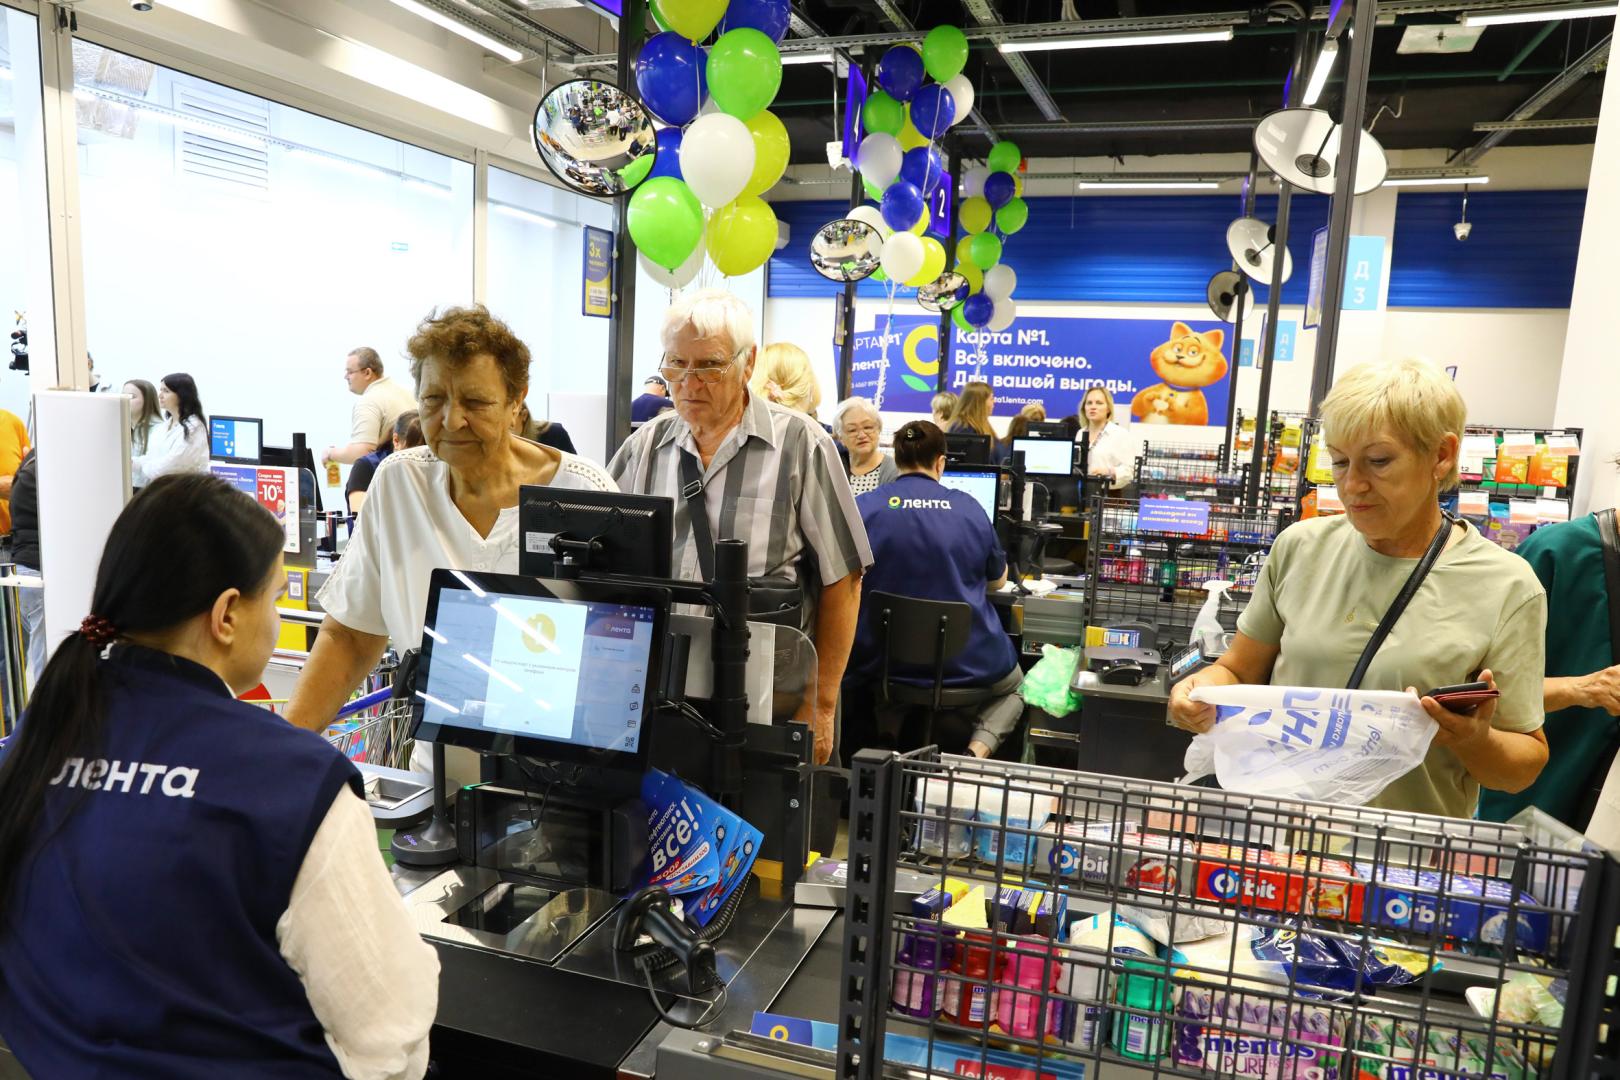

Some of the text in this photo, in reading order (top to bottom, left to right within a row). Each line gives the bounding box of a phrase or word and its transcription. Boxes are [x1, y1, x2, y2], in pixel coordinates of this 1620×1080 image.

[938, 189, 945, 218] 2
[1354, 260, 1370, 281] Д
[1353, 287, 1366, 304] 3
[956, 328, 1050, 349] Карта №1.
[1280, 333, 1289, 345] Д
[955, 349, 1092, 369] Всё включено.
[1279, 349, 1288, 358] 2
[852, 359, 890, 372] лента
[993, 374, 1054, 389] вашей
[1060, 377, 1137, 394] выгоды.
[259, 484, 283, 501] -10%
[902, 497, 952, 510] лента
[610, 625, 632, 635] лента
[49, 757, 200, 799] лента
[1055, 848, 1109, 873] Orbit
[1213, 872, 1276, 900] Orbit
[1204, 1036, 1317, 1060] mentos
[1224, 1057, 1269, 1076] PURE
